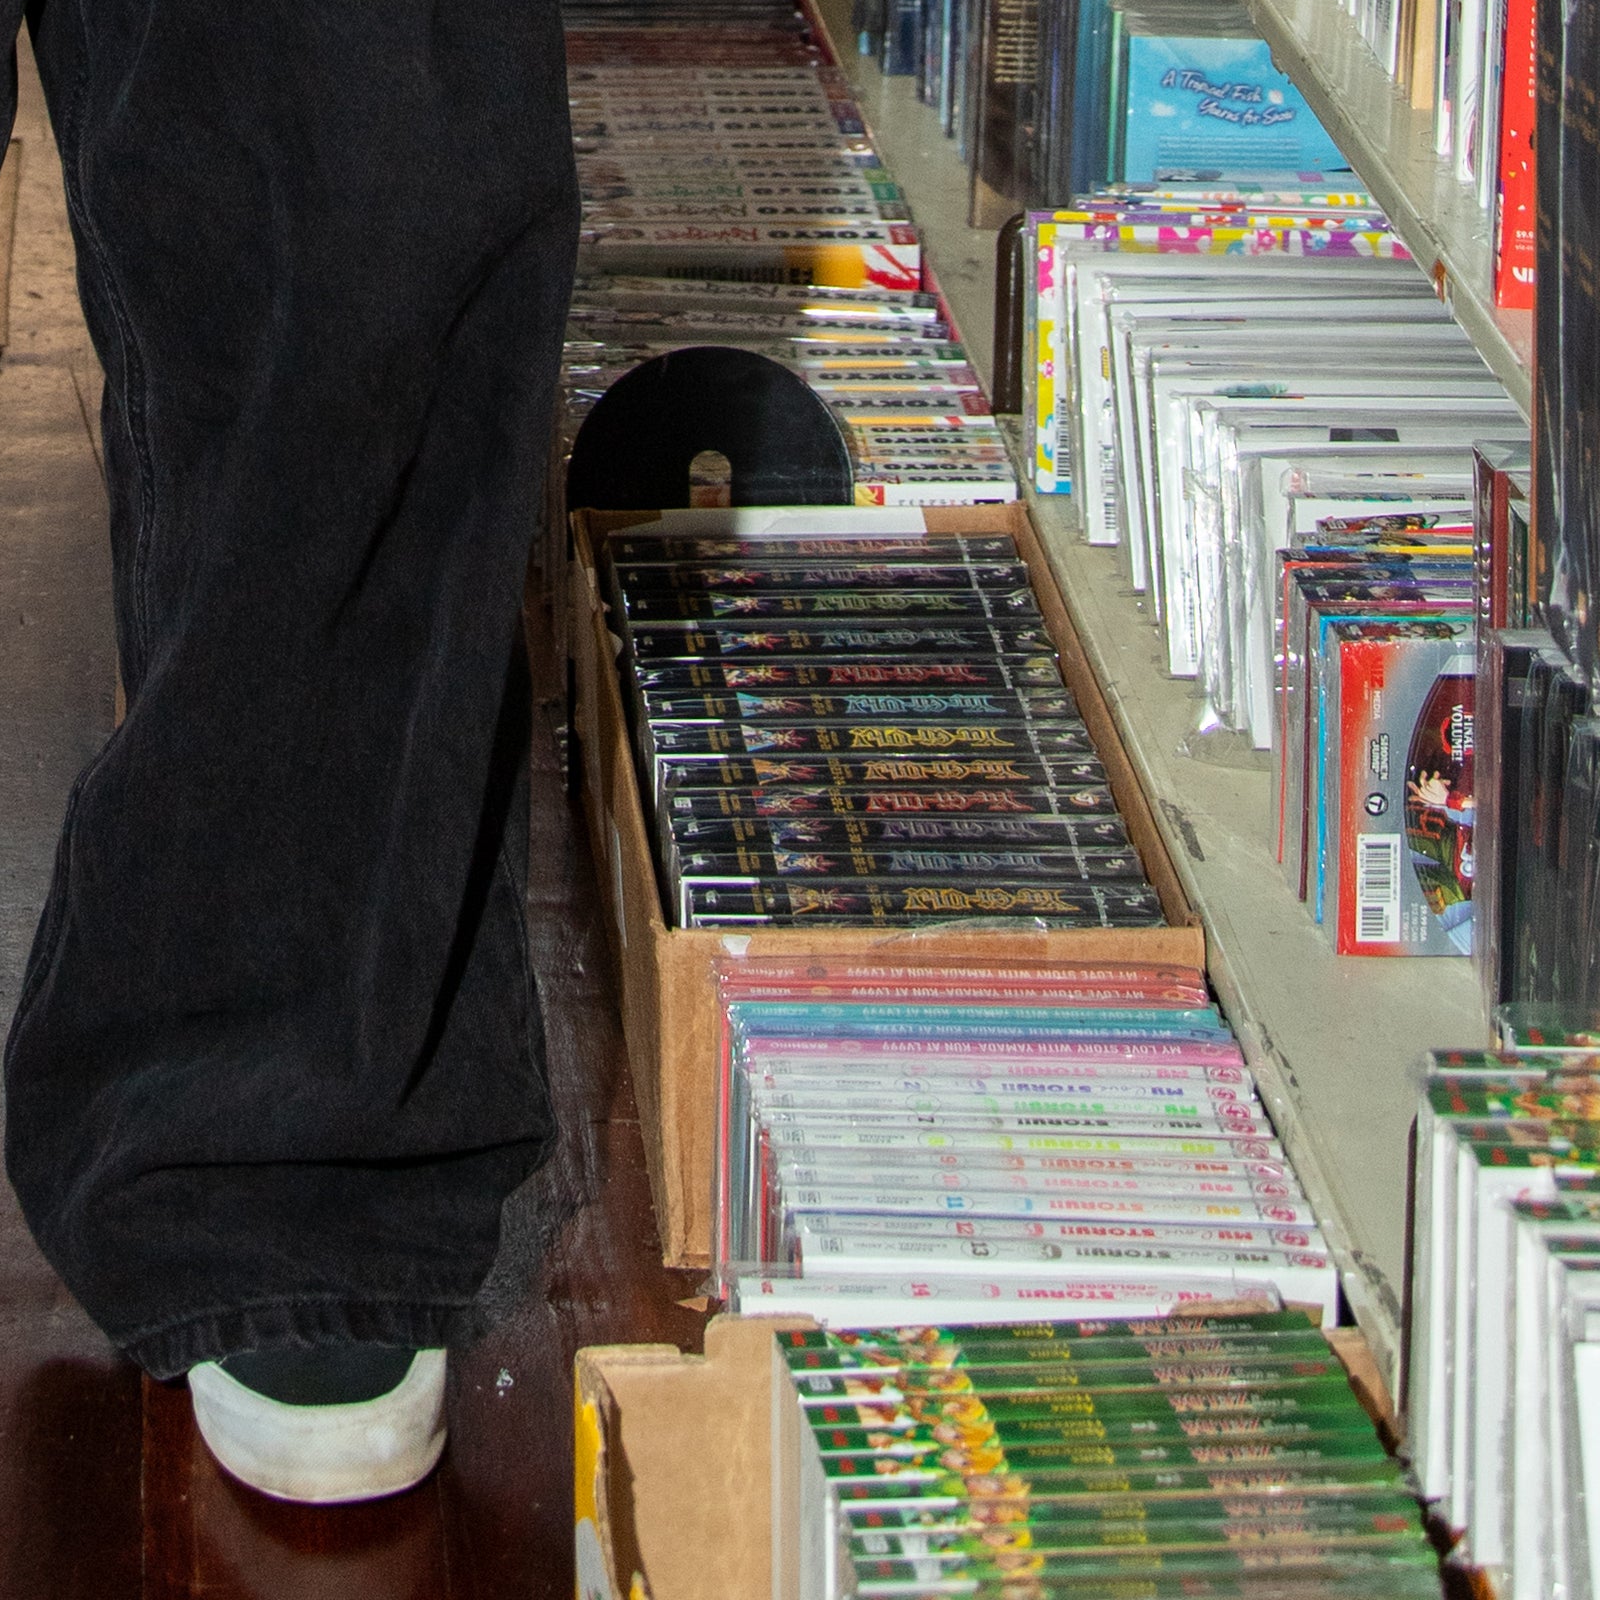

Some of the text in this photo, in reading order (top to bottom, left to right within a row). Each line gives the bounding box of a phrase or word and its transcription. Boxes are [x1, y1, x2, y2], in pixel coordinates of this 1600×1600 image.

[1161, 69, 1176, 88] A
[768, 229, 885, 239] TOKYO
[1515, 230, 1534, 240] $9.9
[808, 348, 929, 356] TOKYO
[820, 372, 943, 380] TOKYO
[827, 400, 956, 408] TOKYO
[1372, 690, 1382, 720] MEDIA
[1451, 704, 1463, 762] VOLUME!
[1463, 714, 1474, 751] FINAL
[1370, 740, 1380, 774] JUMP
[1379, 733, 1389, 780] SHONEN
[890, 968, 902, 977] AT
[998, 968, 1031, 979] WITH
[1036, 970, 1081, 980] STORY
[1086, 971, 1113, 980] LOVE
[1119, 971, 1137, 980] MY
[895, 987, 908, 996] AT
[1003, 988, 1036, 997] WITH
[1042, 989, 1082, 998] STORY
[1087, 990, 1120, 999] LOVE
[1124, 990, 1143, 999] MY
[883, 1041, 1181, 1055] MY LOVE STORY WITH YAMADA-KUN AT LV999
[1060, 1225, 1156, 1238] STORY!!
[1076, 1248, 1172, 1260] STORY!!
